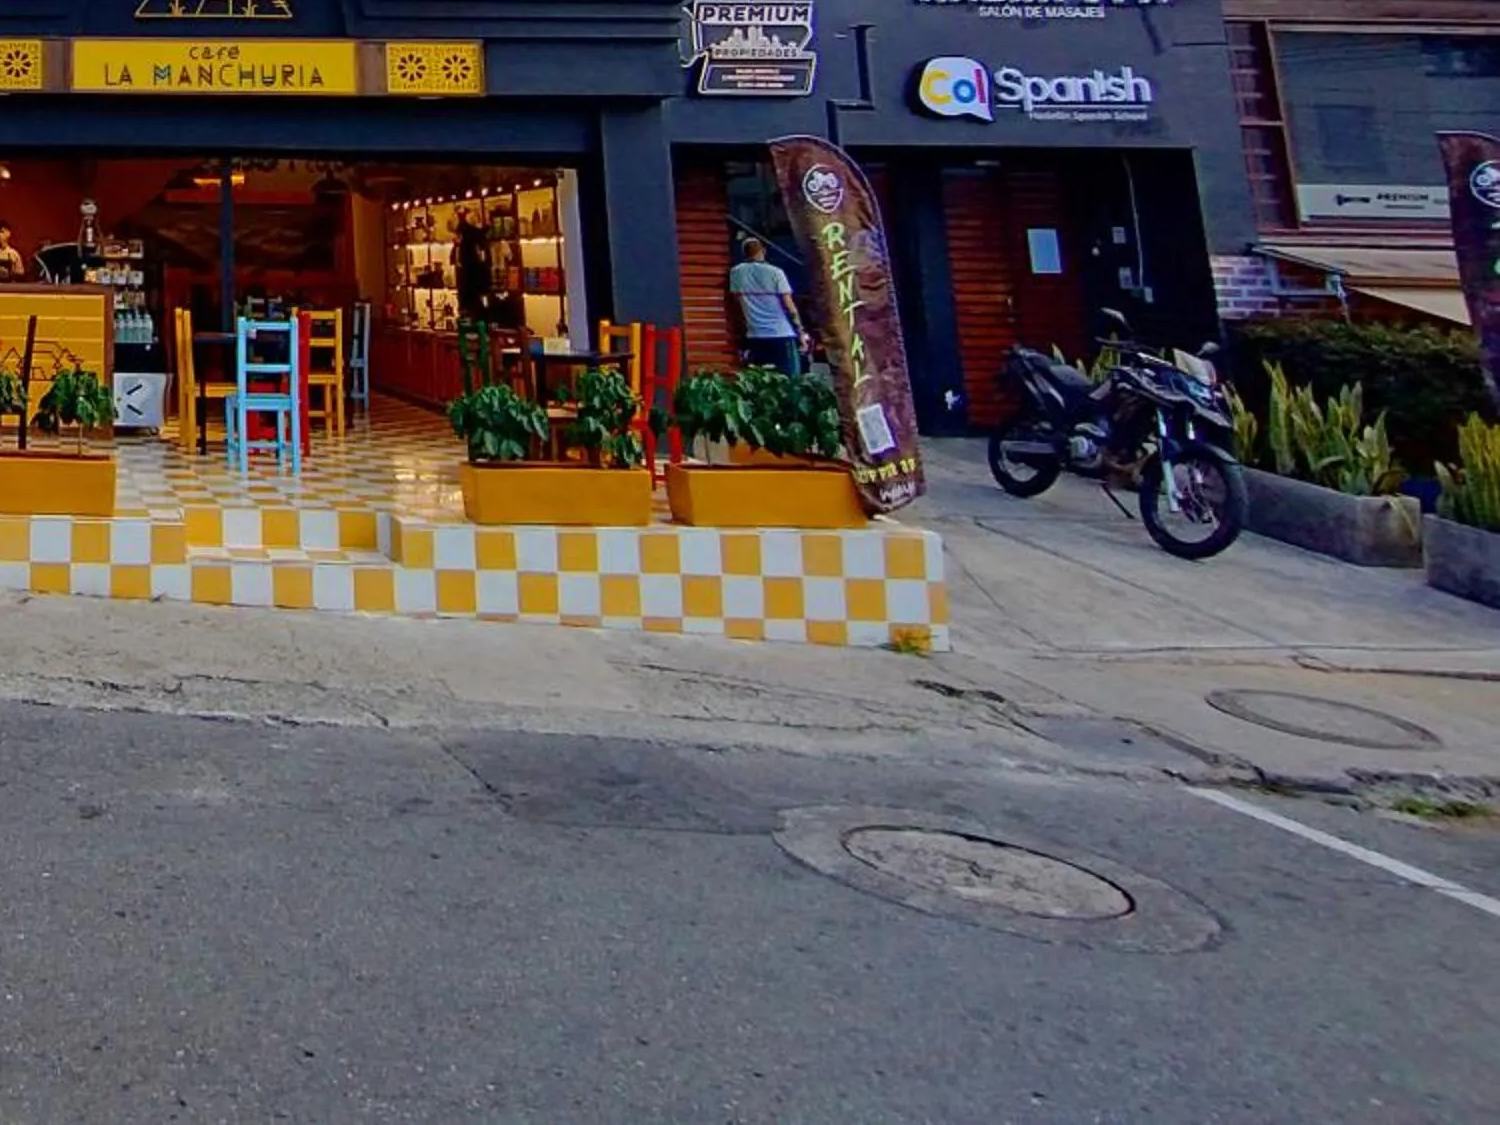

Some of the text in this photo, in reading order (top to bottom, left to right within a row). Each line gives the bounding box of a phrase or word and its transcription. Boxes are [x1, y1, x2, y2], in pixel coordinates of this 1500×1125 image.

[702, 5, 809, 22] PREMIUM
[979, 6, 1105, 18] SALÓN DE MASAJES
[714, 48, 798, 58] PROPIEDADES
[104, 64, 324, 87] LA MANCHURIA
[821, 222, 872, 388] RENTAL
